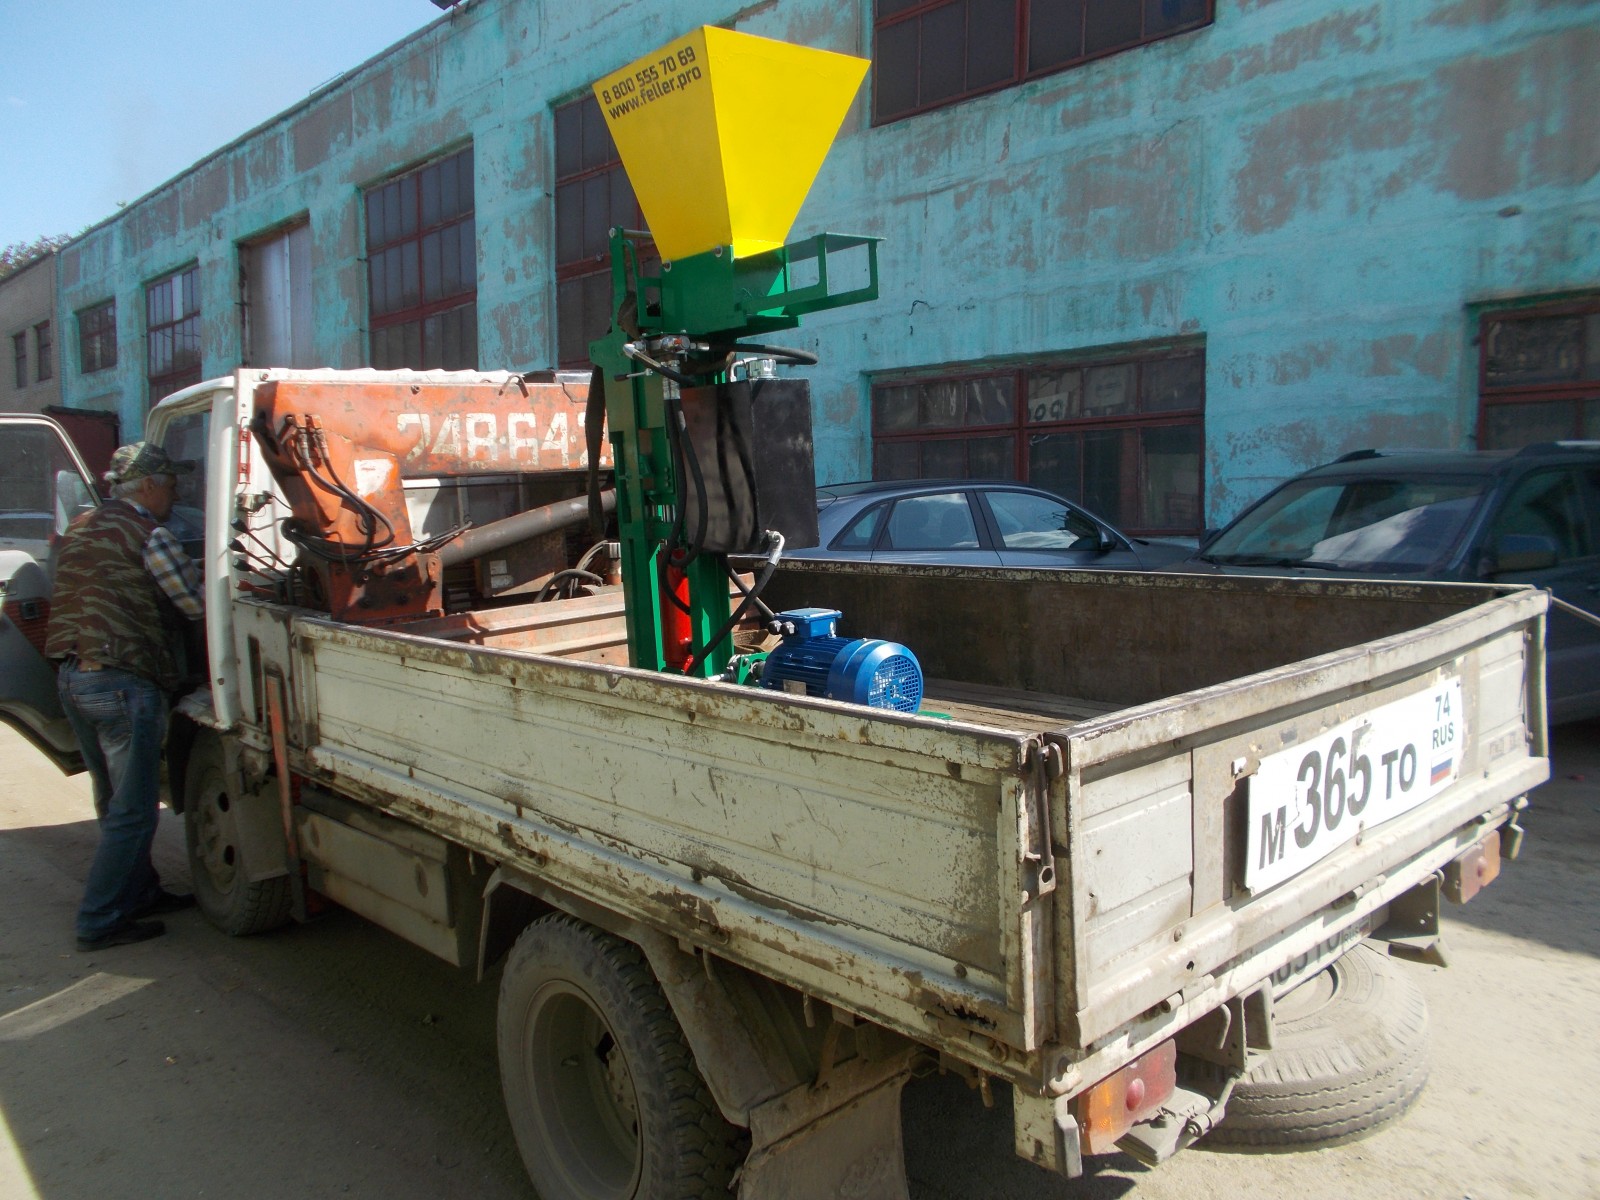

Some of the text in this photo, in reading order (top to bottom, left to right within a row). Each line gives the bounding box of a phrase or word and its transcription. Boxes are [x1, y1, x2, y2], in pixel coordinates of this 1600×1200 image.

[602, 46, 696, 104] 8 800 555 70 69
[608, 66, 702, 120] www.feller.pro
[1435, 691, 1451, 723] 74
[1432, 721, 1454, 750] RUS
[1259, 720, 1417, 871] M 365 TO
